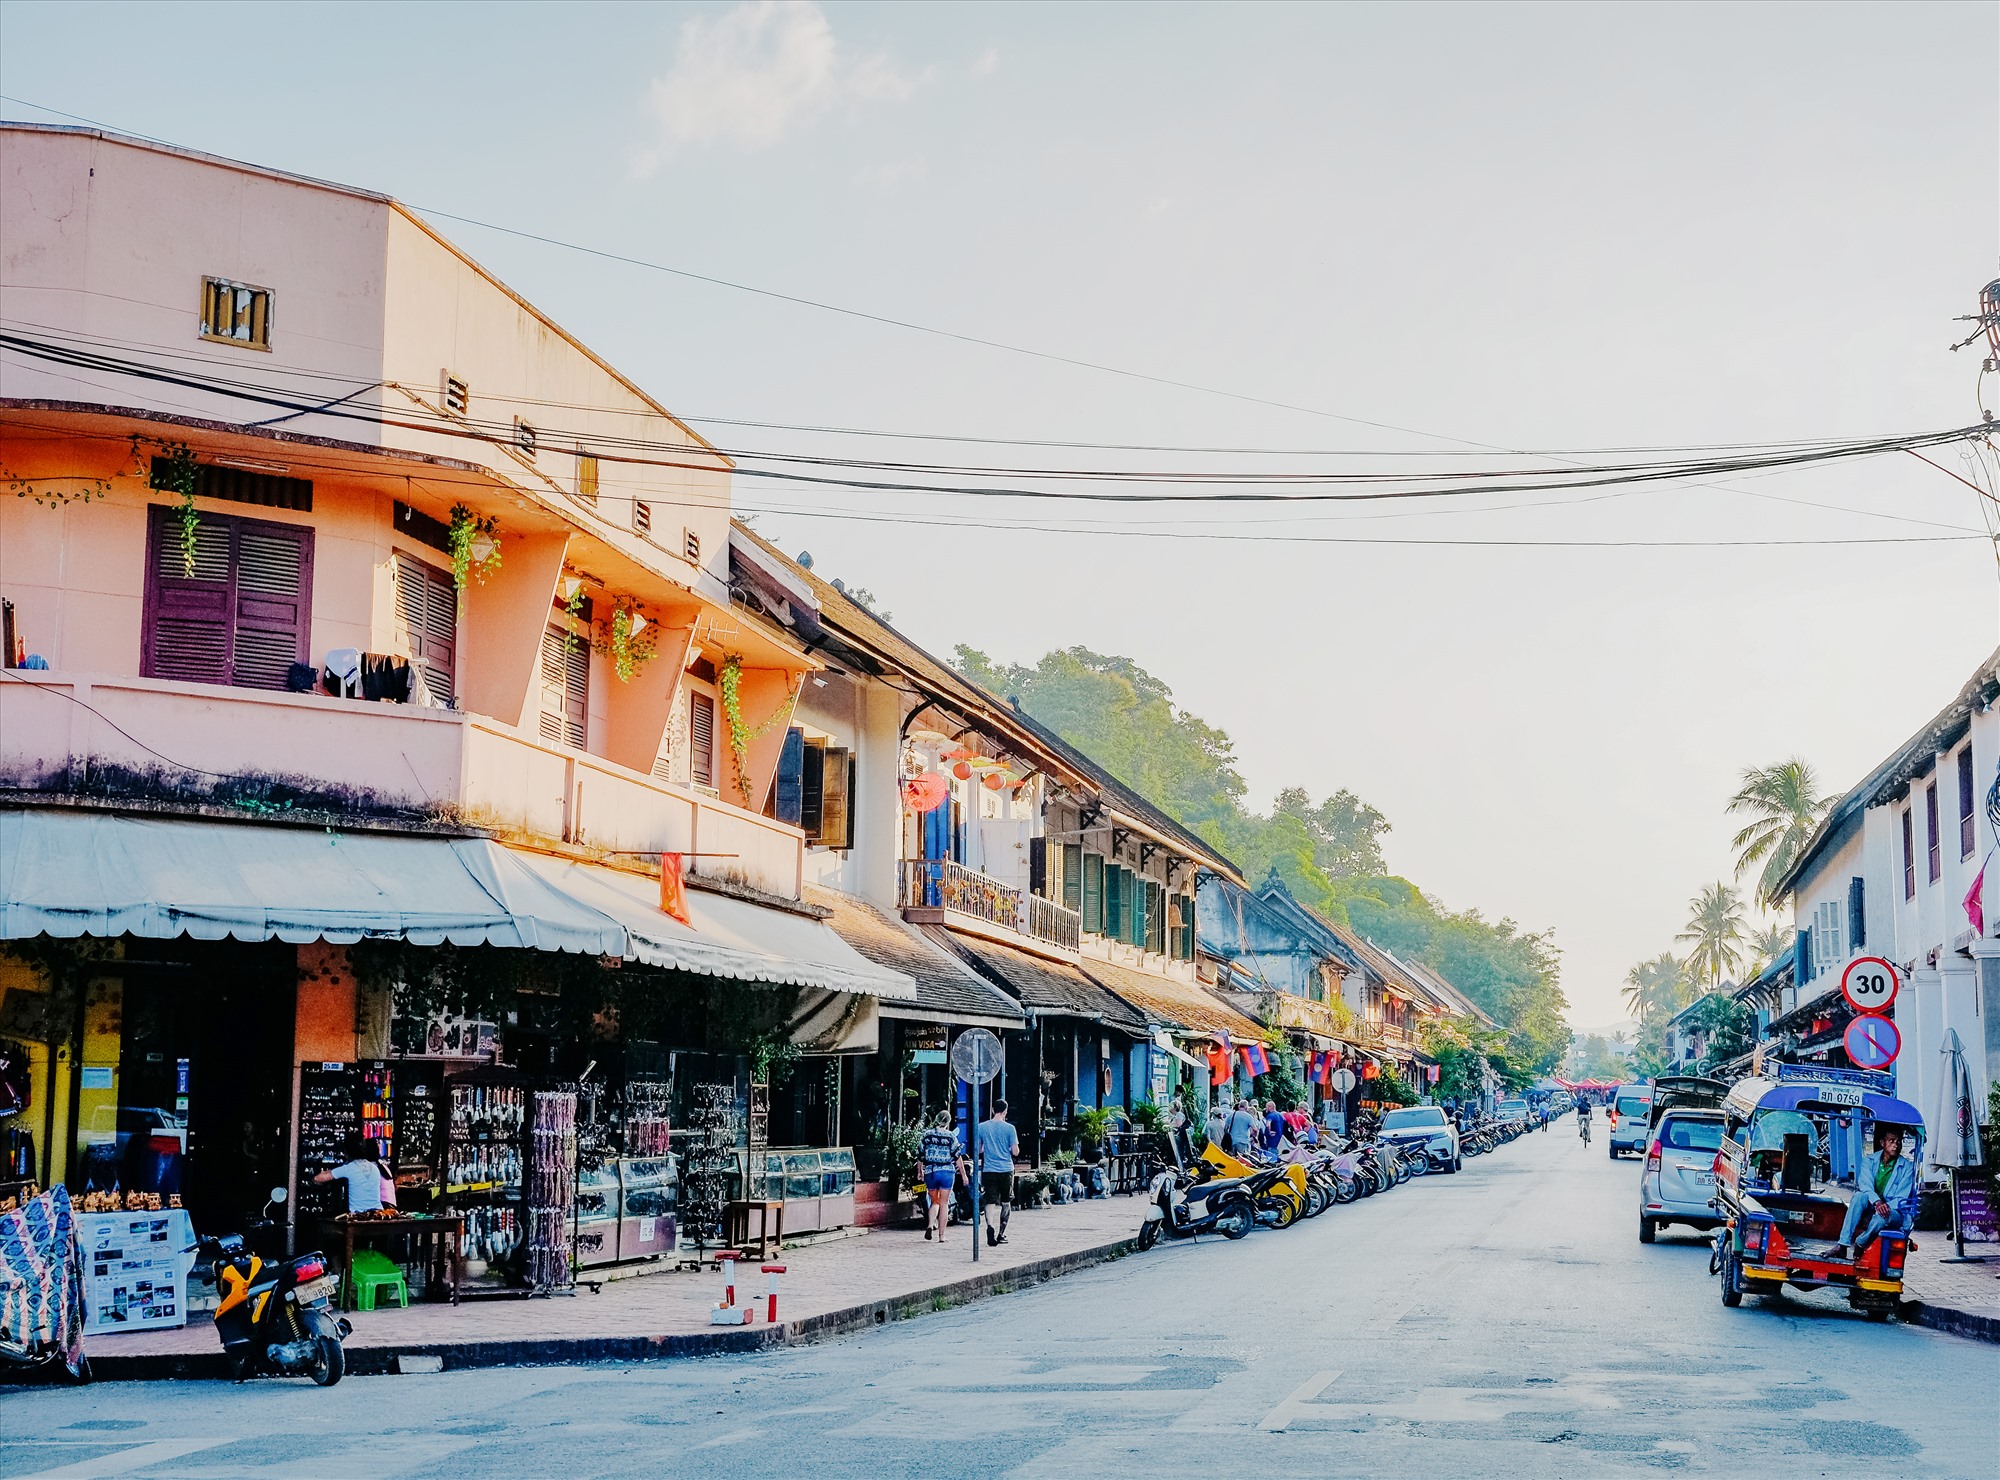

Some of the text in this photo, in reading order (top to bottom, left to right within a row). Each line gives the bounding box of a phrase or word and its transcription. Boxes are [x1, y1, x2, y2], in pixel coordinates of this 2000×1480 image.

[1856, 975, 1885, 994] 30
[918, 1040, 935, 1049] VISA
[1837, 1093, 1860, 1105] 0759
[313, 1285, 333, 1298] 9820
